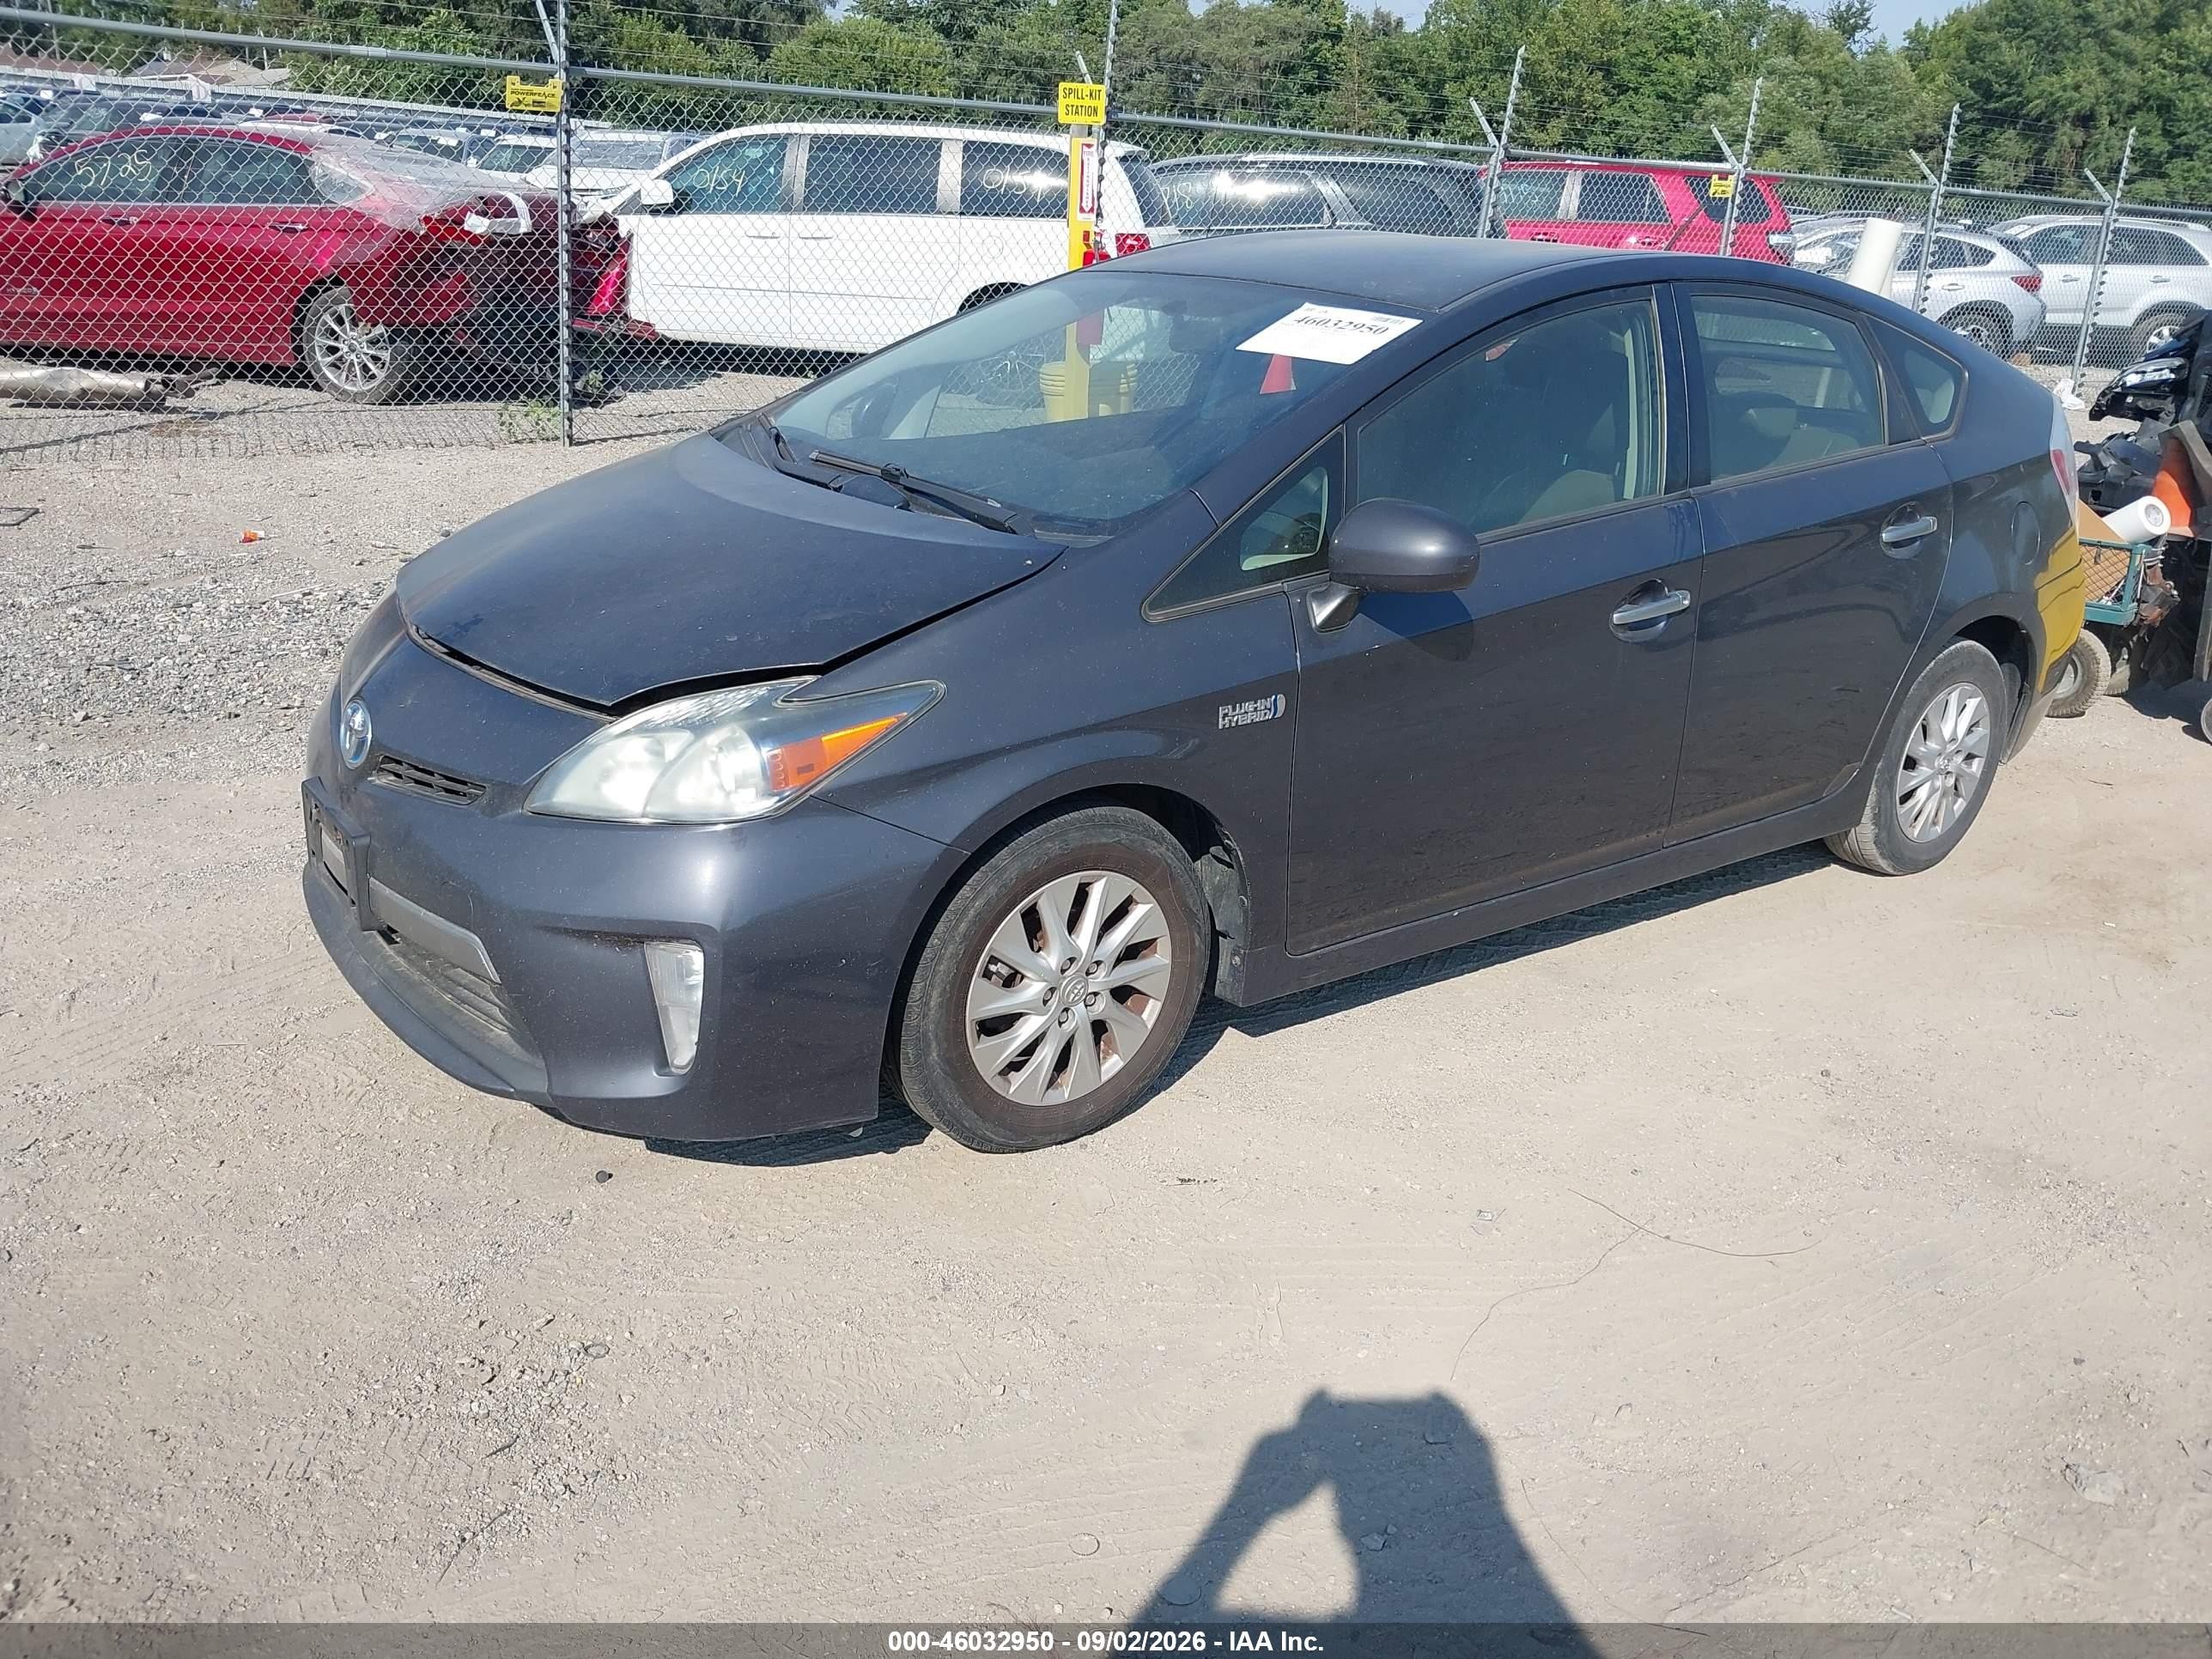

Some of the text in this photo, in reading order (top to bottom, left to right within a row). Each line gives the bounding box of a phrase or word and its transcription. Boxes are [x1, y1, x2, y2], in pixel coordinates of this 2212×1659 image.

[1062, 87, 1102, 101] SPILL-KIT
[1065, 104, 1098, 117] STATION
[75, 149, 152, 187] 5725
[1294, 315, 1389, 336] 46032950
[1219, 698, 1273, 716] PLUG-IN
[1218, 710, 1273, 730] HYBRID
